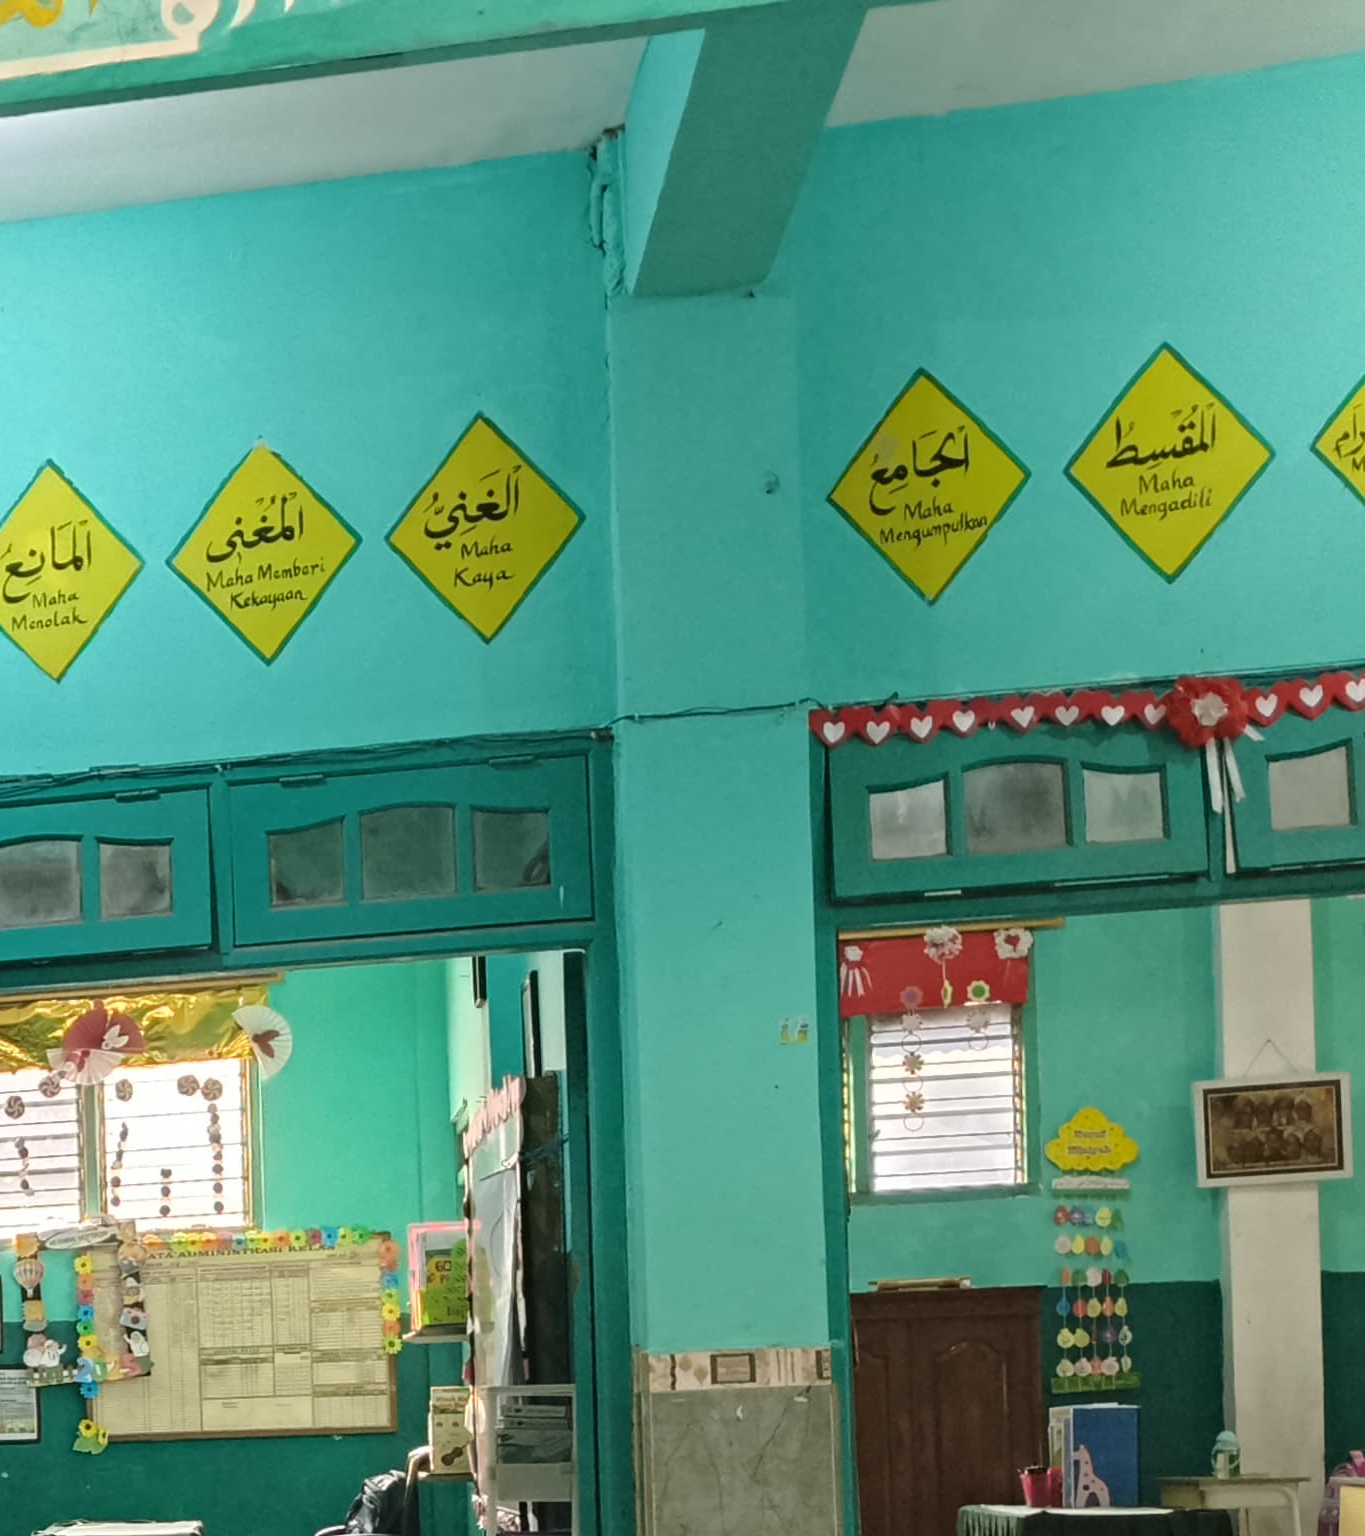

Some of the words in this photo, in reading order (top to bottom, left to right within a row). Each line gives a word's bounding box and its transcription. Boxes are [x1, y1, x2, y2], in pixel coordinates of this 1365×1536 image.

[1138, 466, 1195, 495] Maha
[904, 496, 953, 520] Maha
[1120, 486, 1213, 521] Mengadili
[460, 539, 513, 559] Maha
[206, 567, 253, 591] Maha
[258, 558, 326, 582] Memberi
[453, 566, 515, 592] Kaya
[32, 590, 80, 609] Maha
